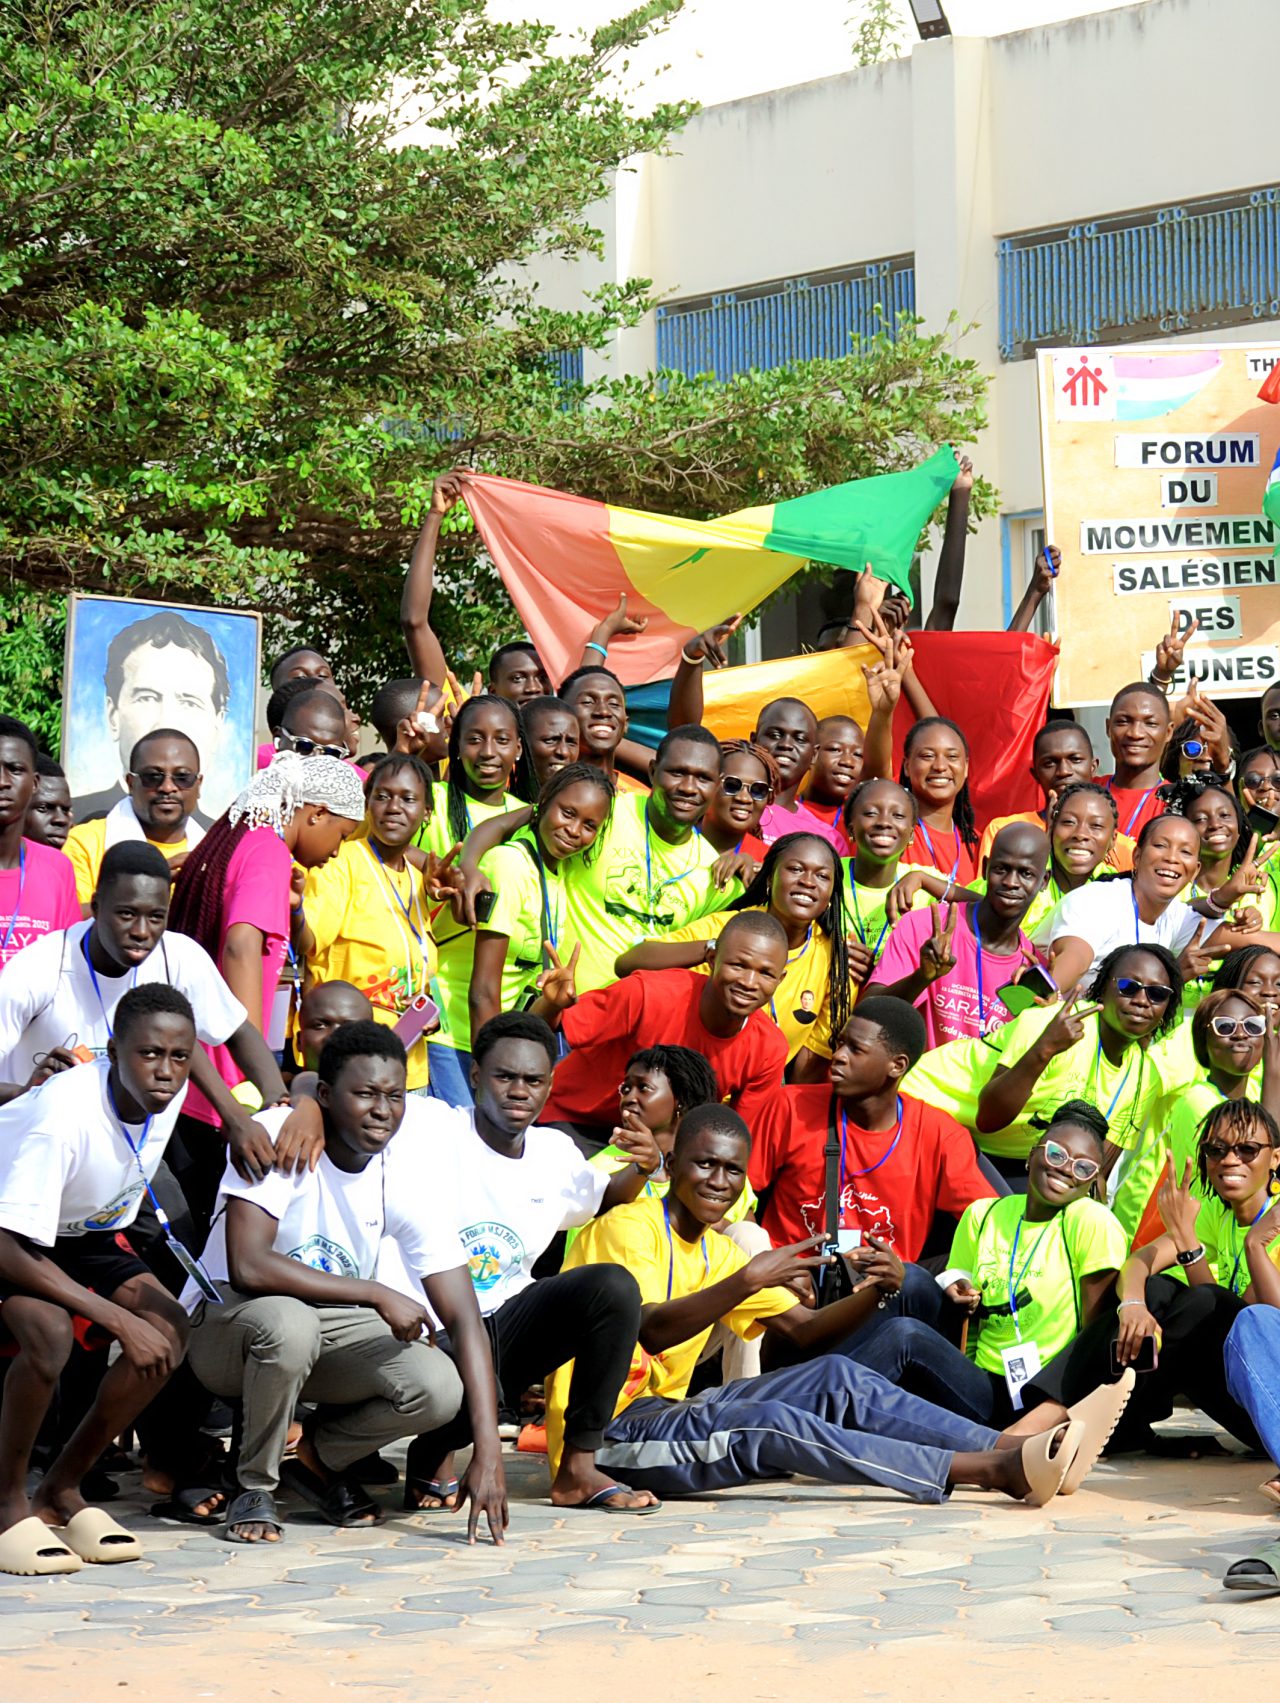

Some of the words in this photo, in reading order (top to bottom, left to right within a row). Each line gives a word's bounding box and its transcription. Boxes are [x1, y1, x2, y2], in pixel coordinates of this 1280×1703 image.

[1250, 358, 1280, 372] TH
[1141, 438, 1254, 465] FORUM
[1167, 479, 1211, 504] DU
[1086, 519, 1276, 551] MOUVEMEN
[1118, 559, 1276, 592] SALÉSIEN
[1173, 606, 1235, 633] DES
[1148, 655, 1276, 684] EUNES
[934, 994, 985, 1016] SARA
